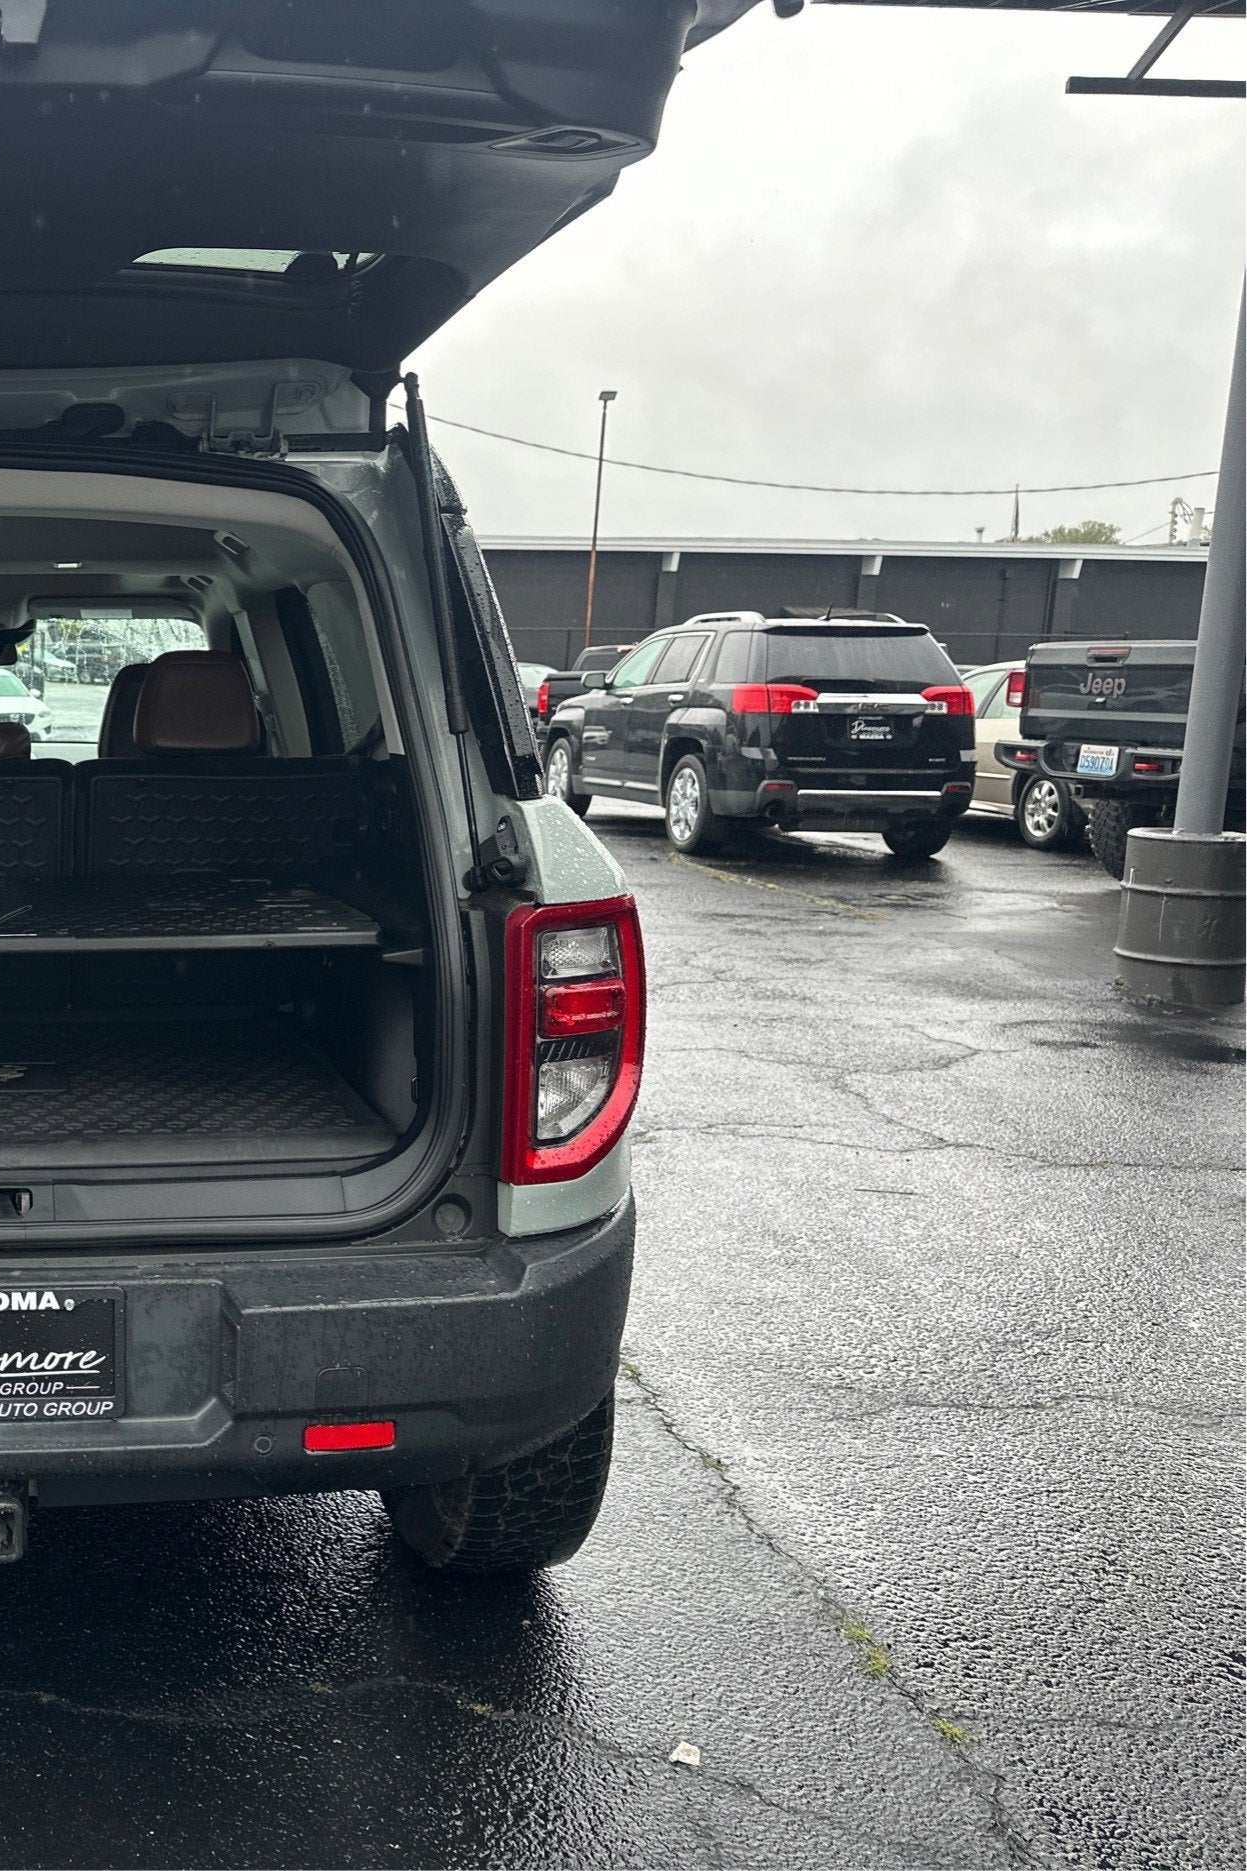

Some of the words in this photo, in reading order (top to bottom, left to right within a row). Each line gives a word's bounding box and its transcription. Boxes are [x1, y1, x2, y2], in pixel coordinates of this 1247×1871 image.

[1079, 672, 1127, 699] Jeep
[0, 1381, 64, 1396] GROUP
[42, 1401, 114, 1417] GROUP
